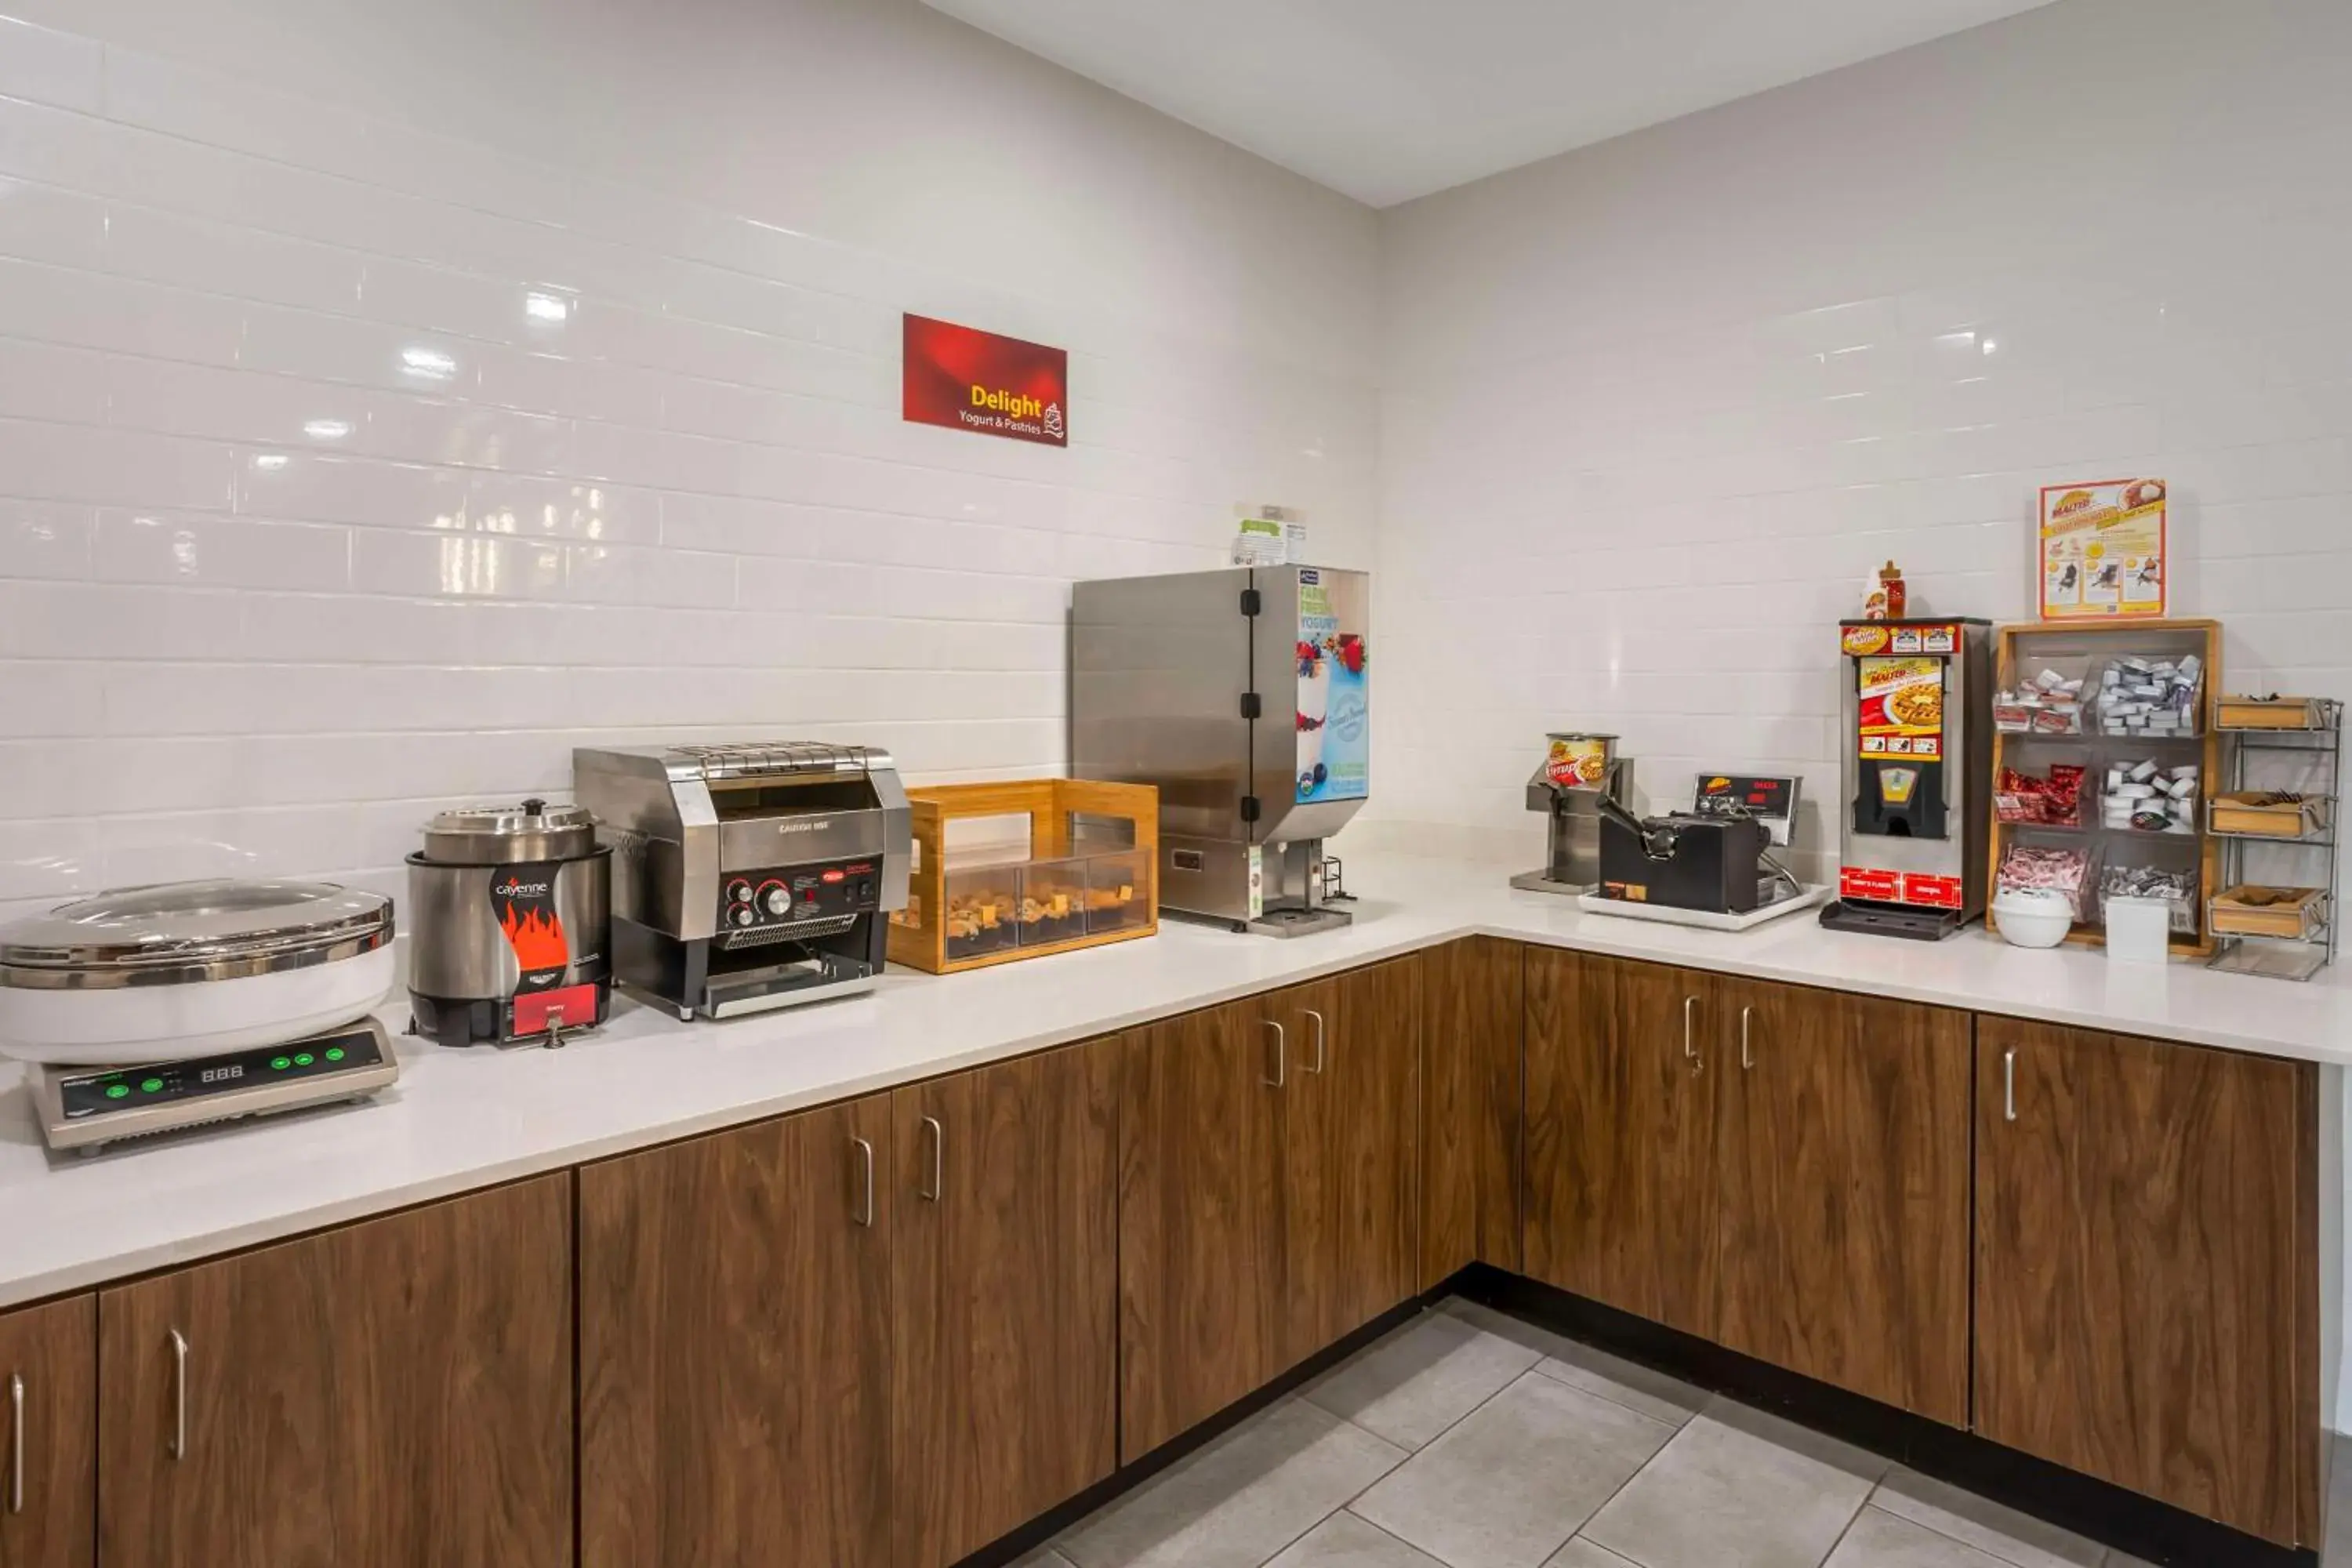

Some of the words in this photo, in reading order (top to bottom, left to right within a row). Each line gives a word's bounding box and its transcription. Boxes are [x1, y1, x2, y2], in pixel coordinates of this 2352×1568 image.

[971, 385, 1042, 418] Delight
[959, 410, 993, 427] Yogurt
[995, 417, 1003, 427] &
[1005, 419, 1041, 435] Pastries
